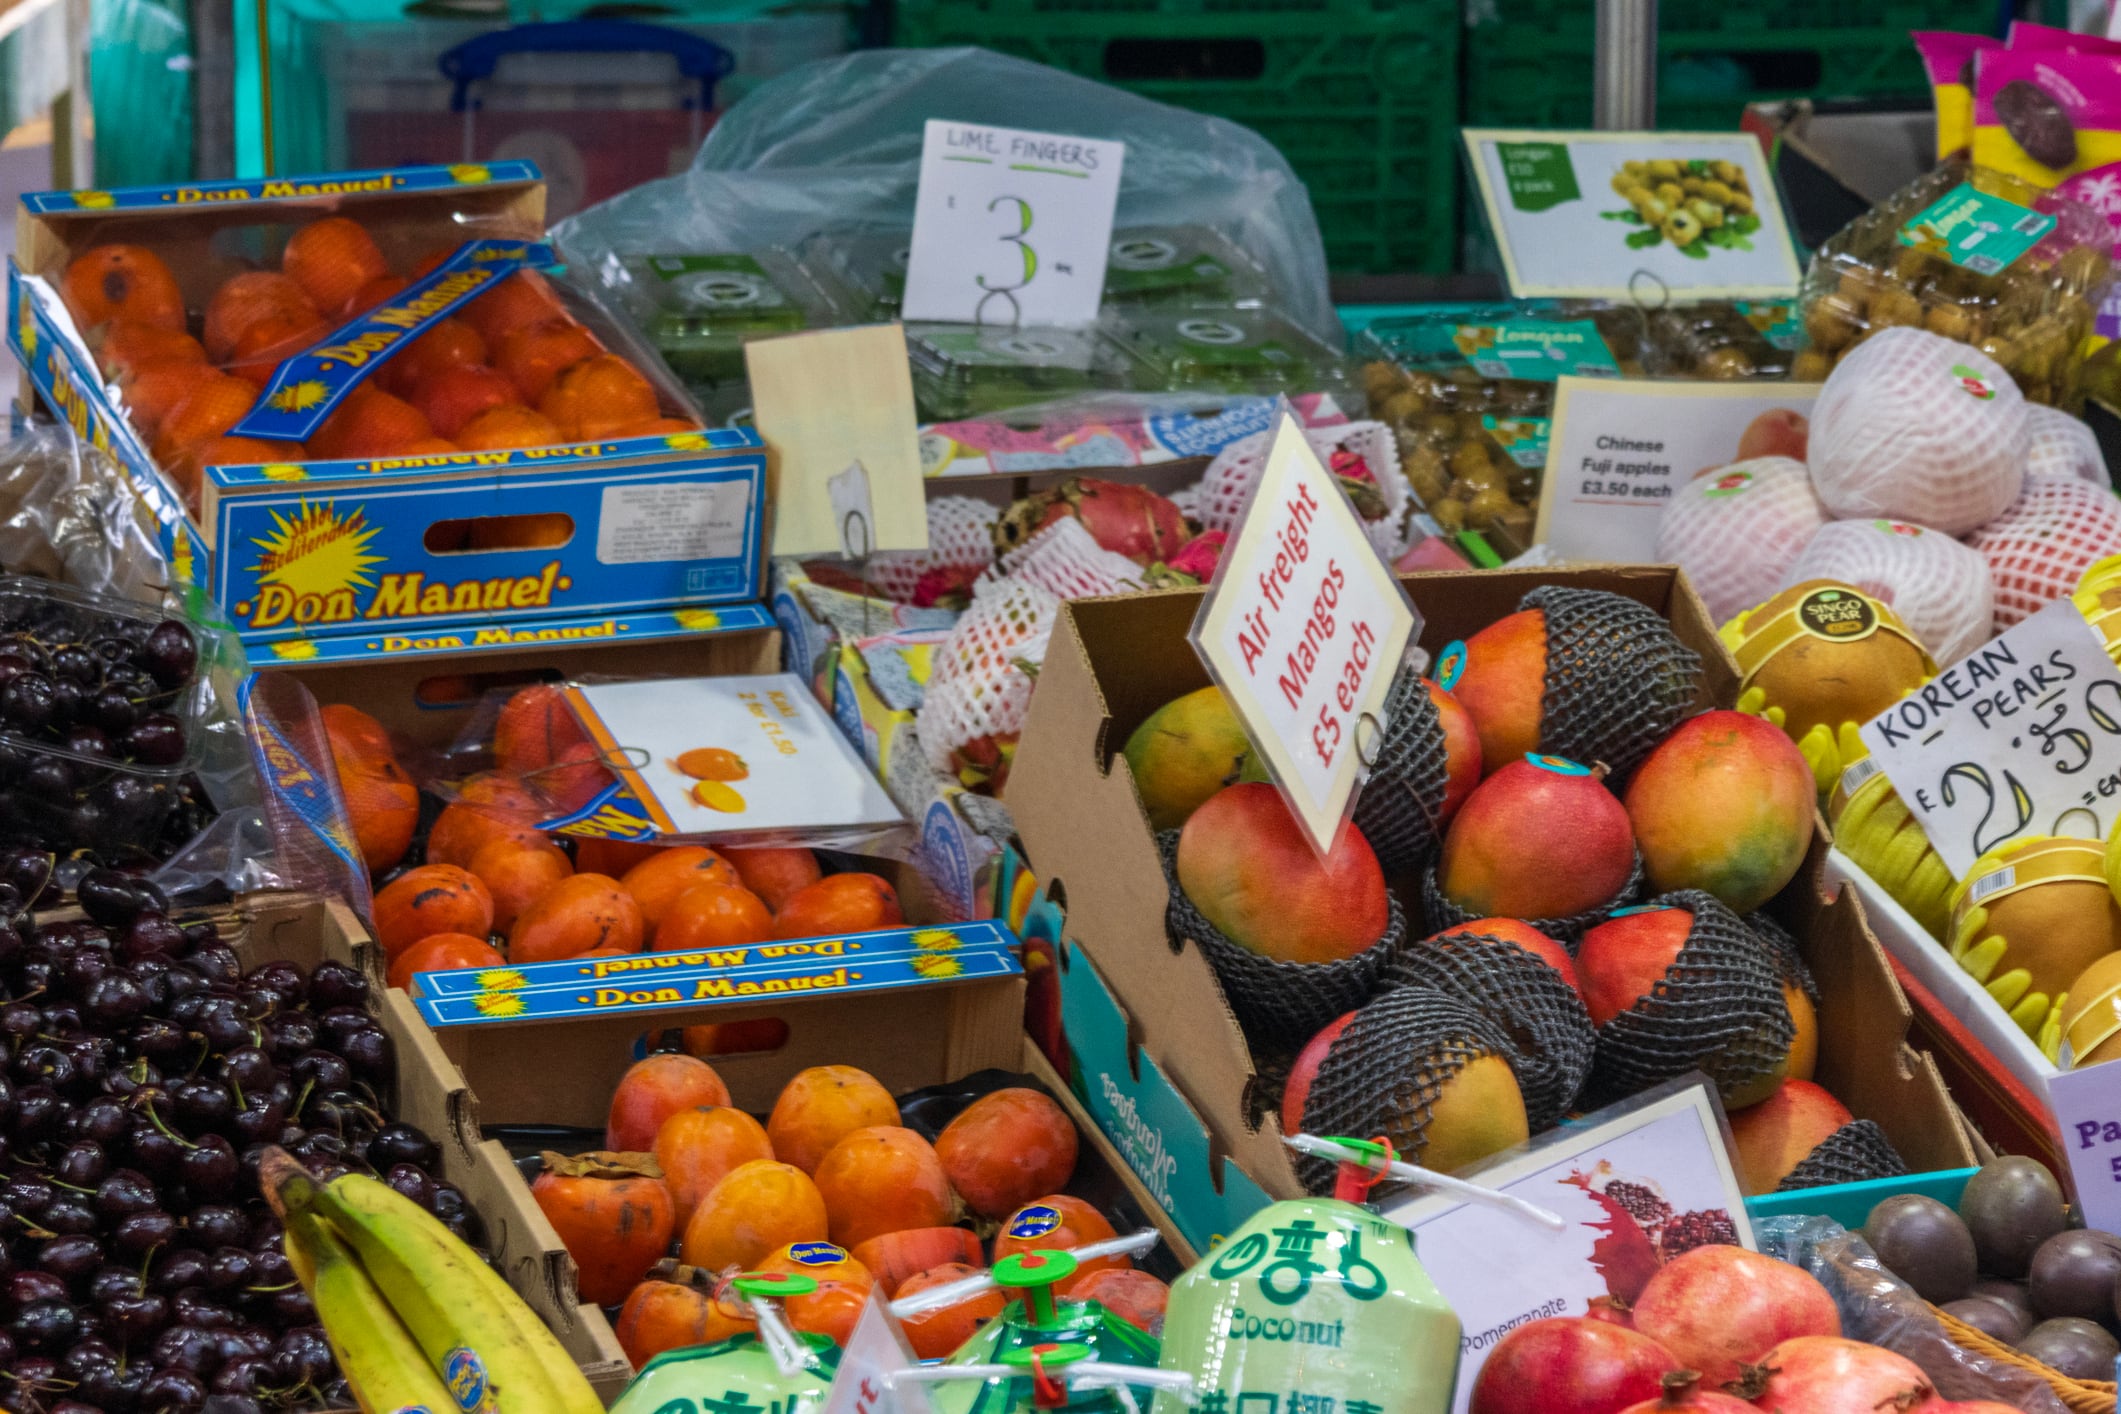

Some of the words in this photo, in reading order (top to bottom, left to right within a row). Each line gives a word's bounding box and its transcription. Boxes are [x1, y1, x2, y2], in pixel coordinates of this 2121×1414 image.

[946, 129, 1000, 154] LIME
[1010, 137, 1100, 170] FINGERS
[176, 188, 250, 205] Don
[260, 173, 394, 200] Manuel
[975, 194, 1038, 291] 3
[311, 331, 403, 368] Don
[370, 450, 513, 475] Manuel
[524, 442, 601, 460] Don
[1595, 435, 1665, 453] Chinese
[1581, 457, 1613, 477] Fuji
[1614, 461, 1672, 478] apples
[1581, 480, 1630, 497] £3.50
[1632, 484, 1673, 498] each
[249, 582, 359, 629] Don
[364, 560, 564, 619] Manuel
[1236, 603, 1275, 678] Air
[1258, 481, 1320, 613] freight
[1806, 599, 1862, 616] SINGO
[1816, 610, 1862, 624] PEAR
[382, 635, 465, 653] Don
[472, 621, 617, 648] Manuel
[1277, 557, 1346, 711] Mangos
[1311, 702, 1343, 770] £5
[1336, 617, 1377, 715] each
[1875, 638, 2019, 748] KOREAN
[1971, 648, 2078, 730] PEARS
[593, 949, 750, 979] Manuel
[758, 940, 846, 959] Don
[594, 988, 683, 1007] Don
[692, 968, 849, 1001] Manuel
[1228, 1307, 1345, 1348] Coconut
[1462, 1297, 1568, 1356] Pomegranate
